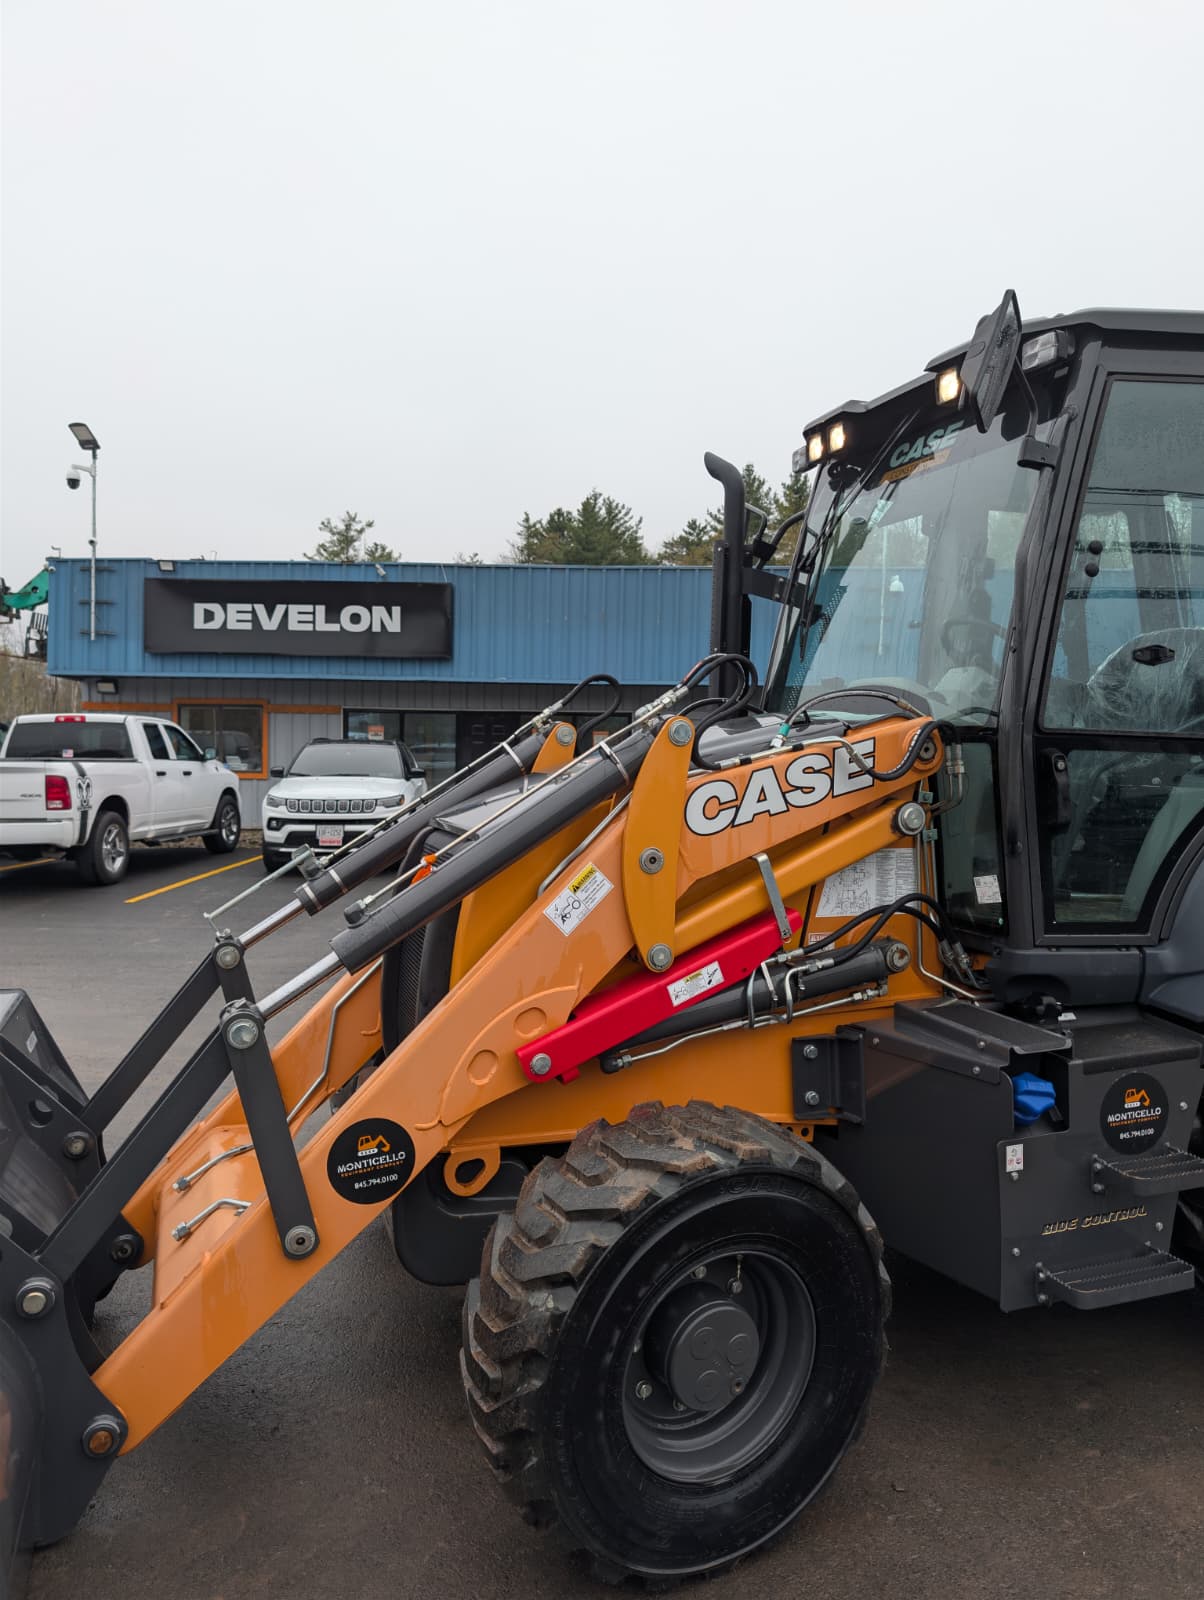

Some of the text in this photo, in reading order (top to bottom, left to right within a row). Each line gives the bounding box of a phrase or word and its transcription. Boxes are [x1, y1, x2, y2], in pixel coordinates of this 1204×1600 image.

[889, 419, 965, 468] CASE
[193, 602, 402, 633] DEVELON
[684, 736, 876, 836] CASE
[1107, 1106, 1162, 1122] MONTICELLO
[337, 1151, 406, 1174] MONTICELLO
[354, 1173, 399, 1190] 845.794.0100
[1081, 1205, 1148, 1229] CONTROL
